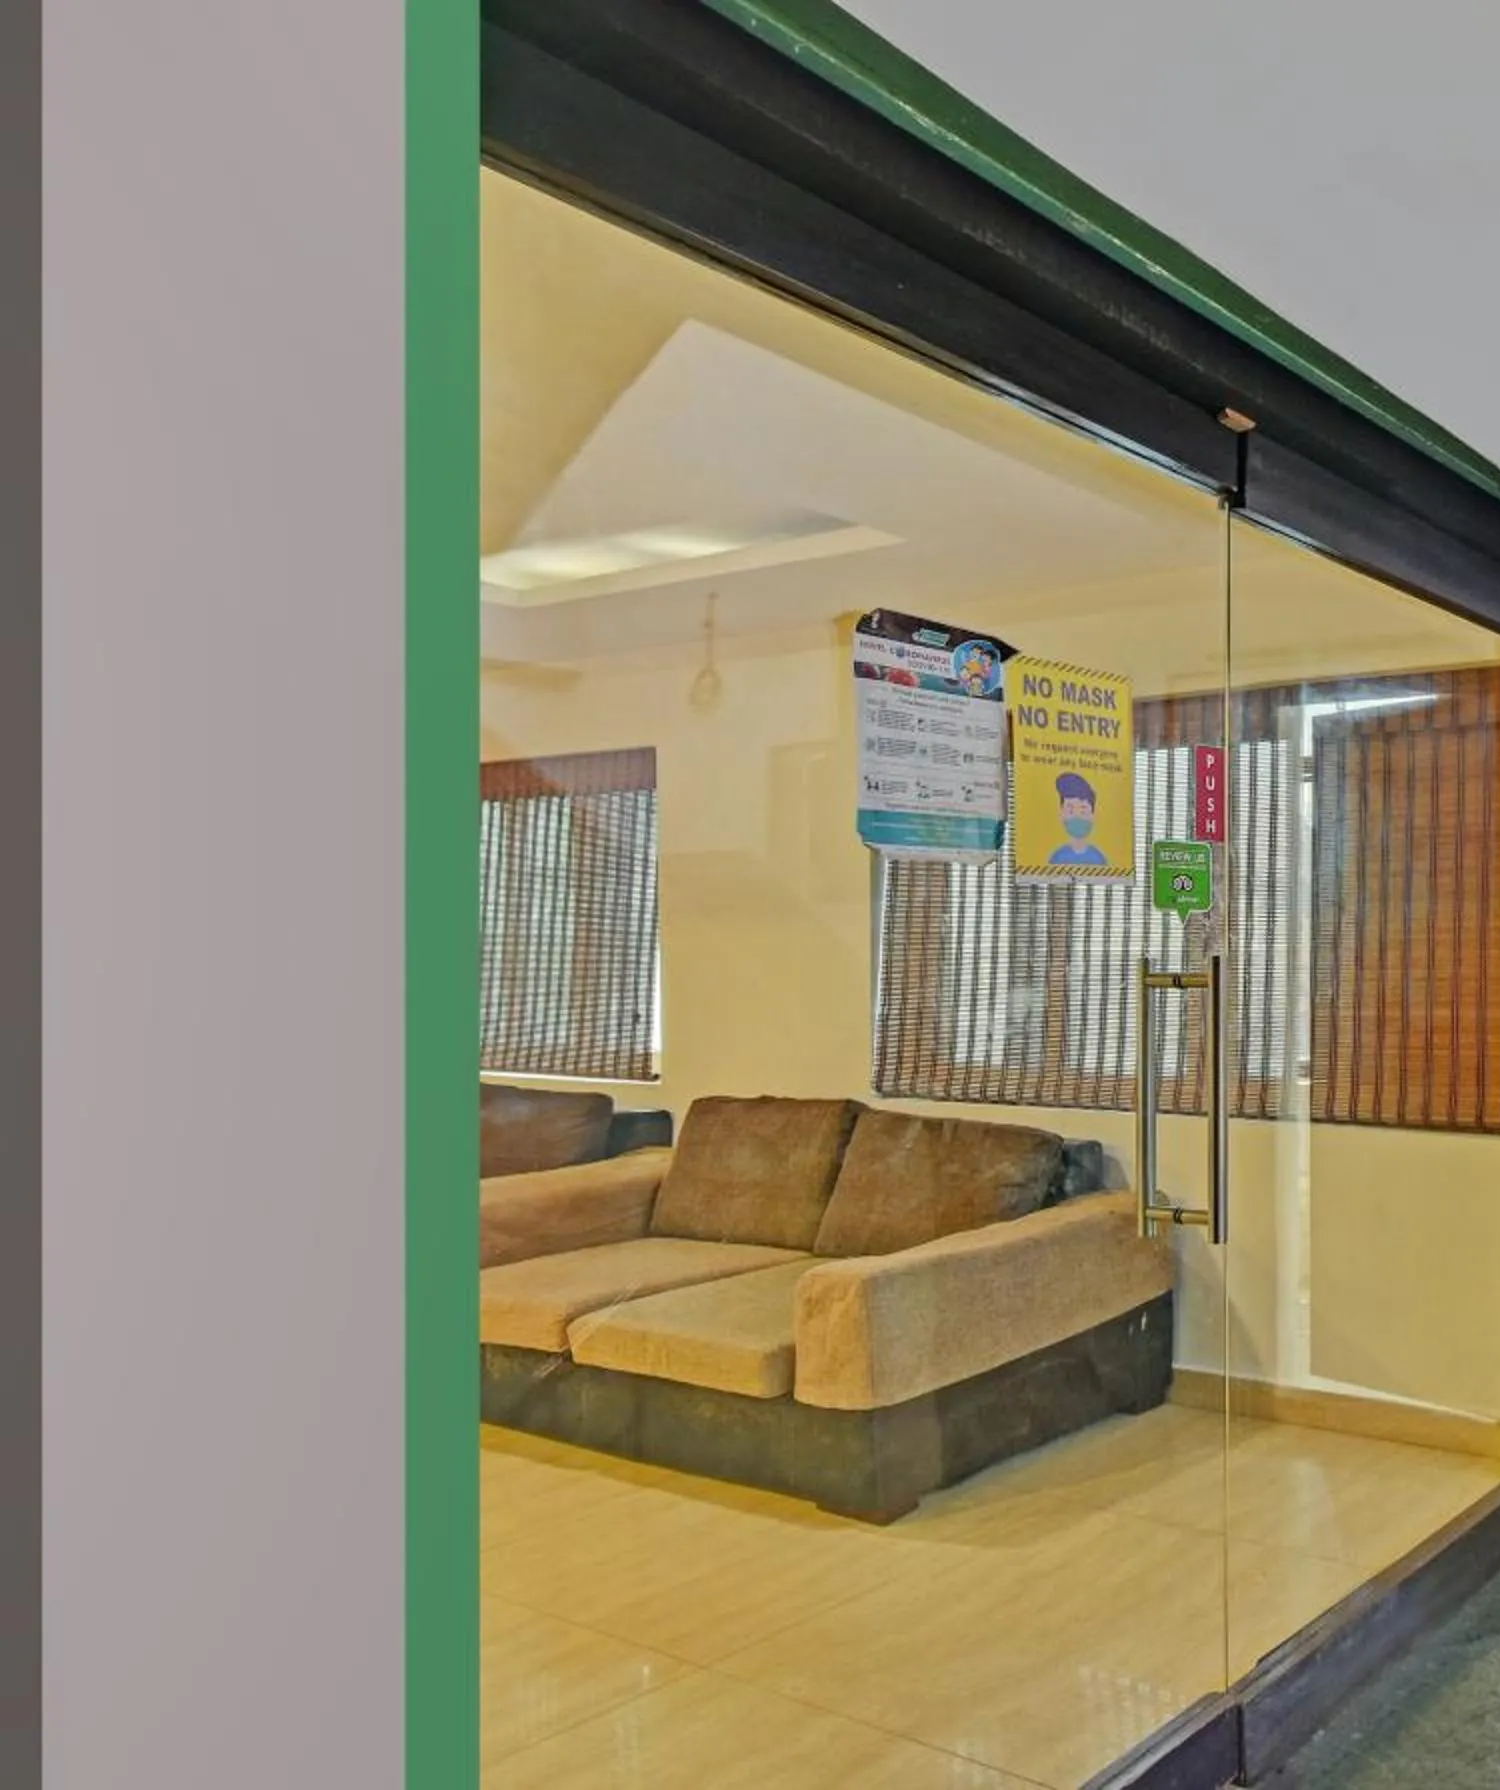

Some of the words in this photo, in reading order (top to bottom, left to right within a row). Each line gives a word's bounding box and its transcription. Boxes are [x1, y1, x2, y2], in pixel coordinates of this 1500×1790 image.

[1023, 673, 1053, 699] NO
[1061, 681, 1118, 711] MASK
[1018, 703, 1049, 729] NO
[1057, 710, 1121, 739] ENTRY
[1205, 754, 1217, 834] PUSH
